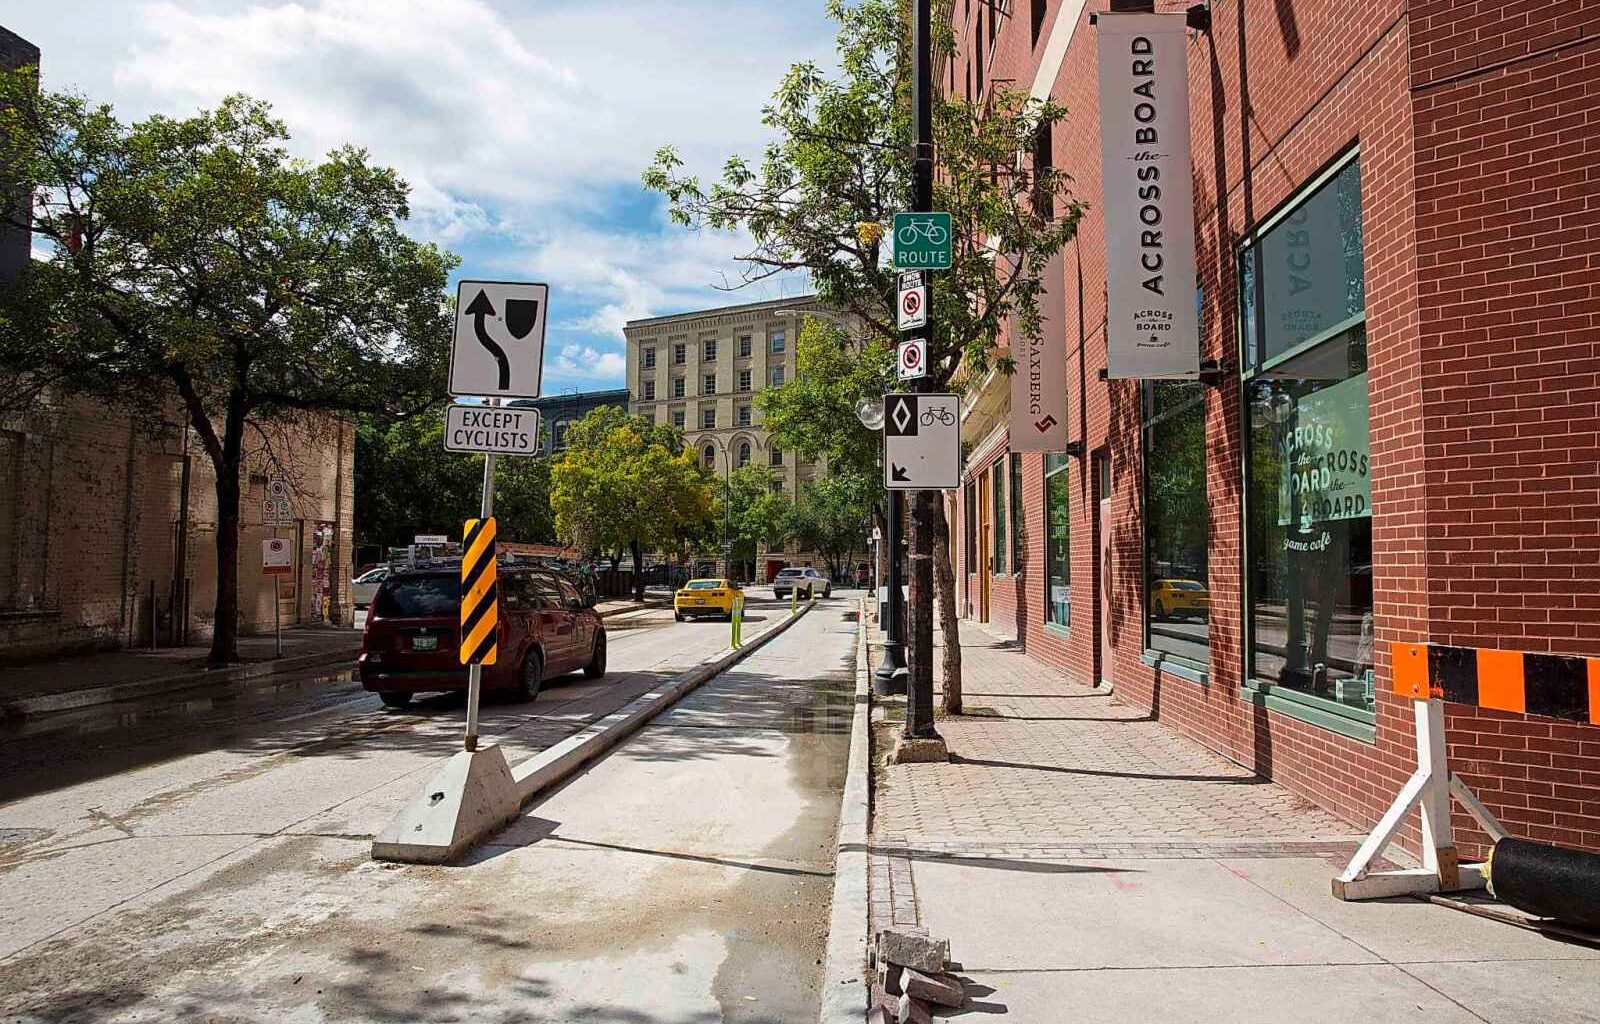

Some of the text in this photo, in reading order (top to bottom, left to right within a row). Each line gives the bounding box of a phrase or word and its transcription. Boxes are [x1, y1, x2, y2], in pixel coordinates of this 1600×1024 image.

[1131, 35, 1165, 297] ACROSS the BOARD
[898, 251, 947, 264] ROUTE
[1133, 310, 1173, 321] ACROSS
[1136, 323, 1172, 331] BOARD
[1029, 336, 1044, 416] SAXBERG
[462, 410, 523, 430] EXCEPT
[454, 429, 529, 449] CYCLISTS
[1297, 452, 1312, 466] the
[1315, 449, 1369, 477] CROSS
[1292, 467, 1330, 495] OARD
[1330, 478, 1345, 491] the
[1312, 494, 1365, 518] BOARD
[1283, 537, 1309, 551] game
